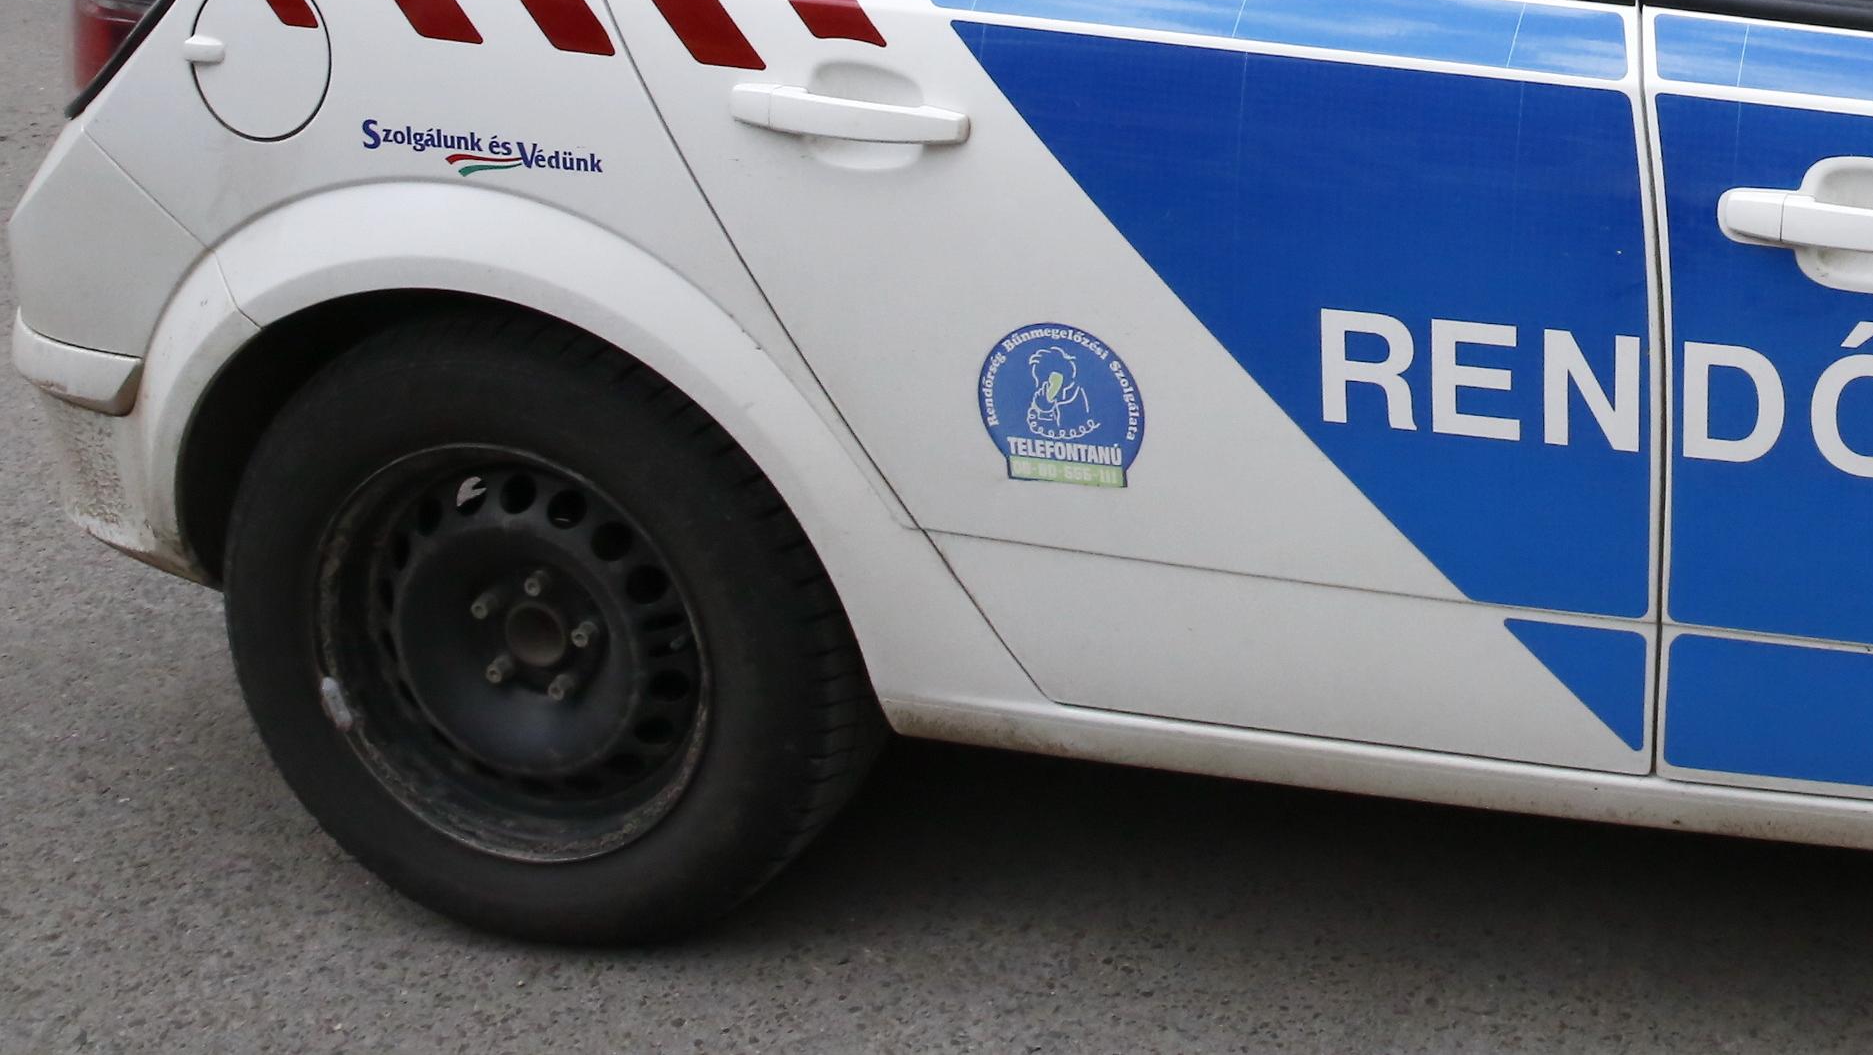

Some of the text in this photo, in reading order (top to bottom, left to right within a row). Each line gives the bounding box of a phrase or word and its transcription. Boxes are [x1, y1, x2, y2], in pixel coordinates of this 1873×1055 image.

[361, 119, 604, 173] Szolgálunk és Védünk
[982, 327, 1140, 441] Rendőrség Bűnmegelőzési Szolgálata
[1007, 436, 1123, 466] TELEFONTANÚ
